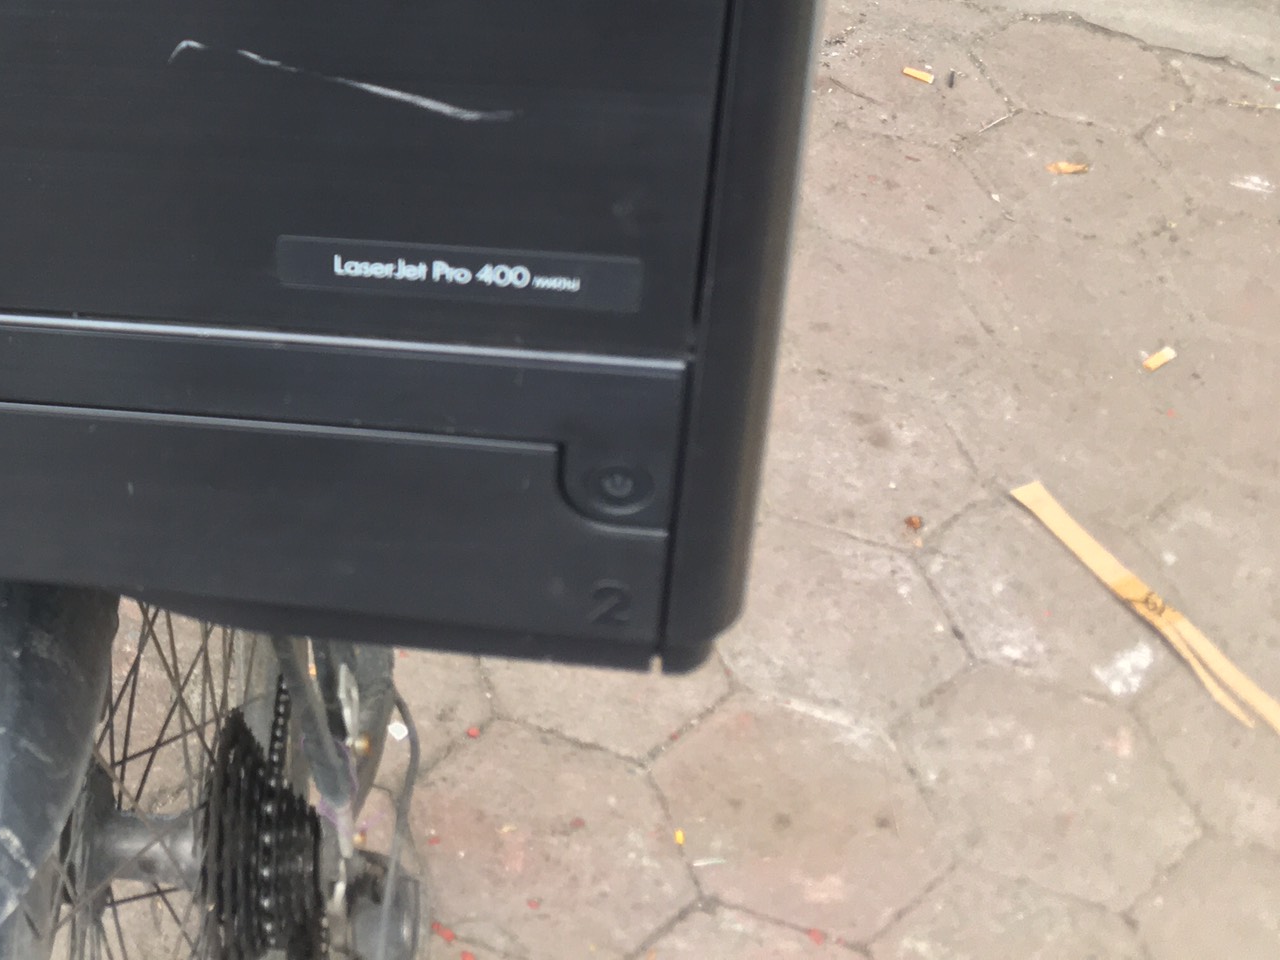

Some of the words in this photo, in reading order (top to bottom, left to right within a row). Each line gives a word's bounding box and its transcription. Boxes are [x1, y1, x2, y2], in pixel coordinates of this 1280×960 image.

[333, 254, 428, 281] LaserJet
[431, 260, 472, 284] Pro
[475, 263, 531, 289] 400
